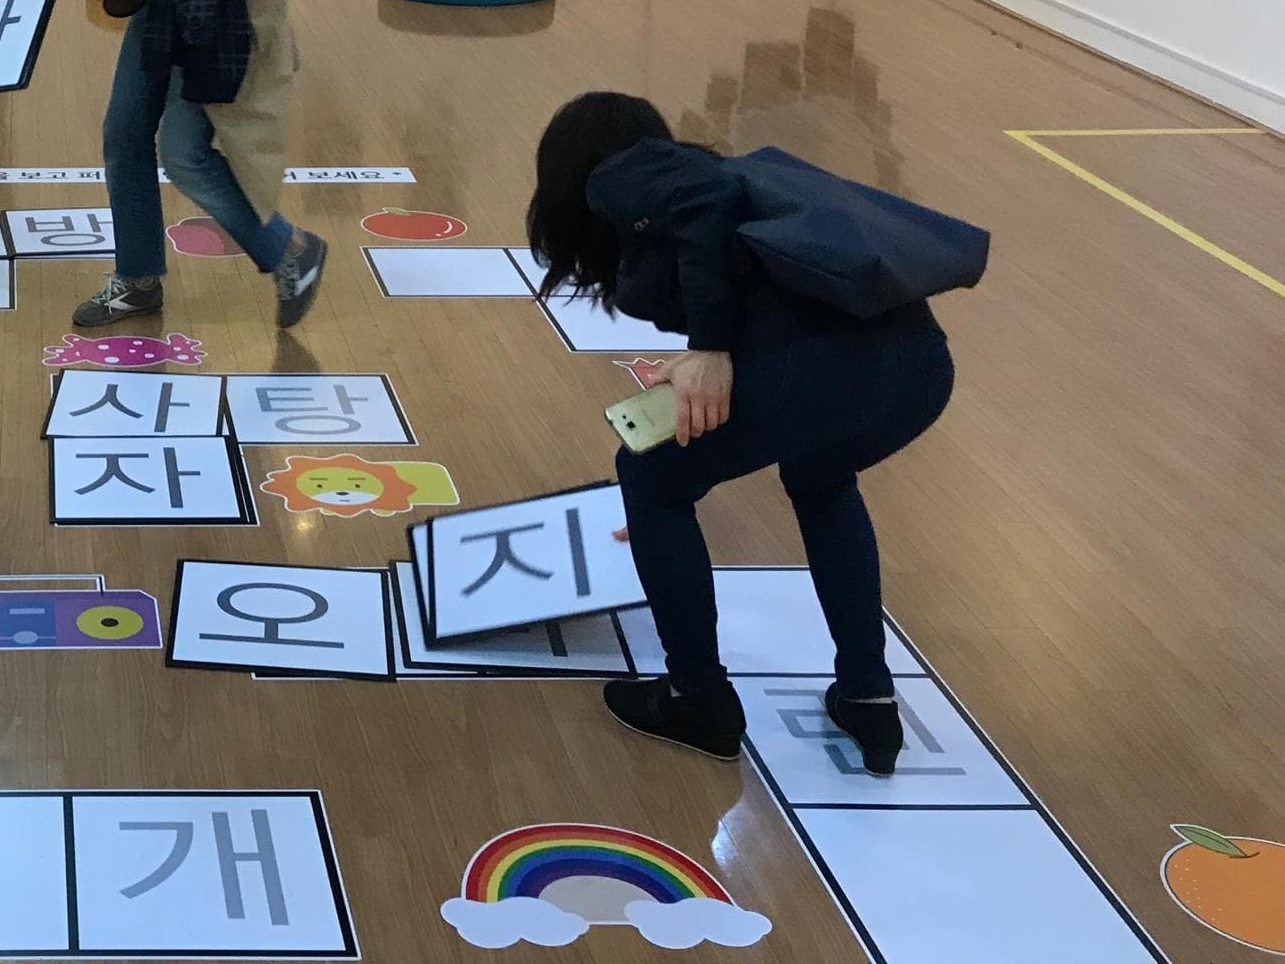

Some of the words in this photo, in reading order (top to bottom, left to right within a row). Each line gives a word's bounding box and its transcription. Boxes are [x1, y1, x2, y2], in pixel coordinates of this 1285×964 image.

[307, 171, 384, 179] 보세요
[25, 213, 113, 246] 방
[69, 381, 191, 433] 사
[255, 384, 369, 436] 탕
[74, 446, 201, 509] 자
[458, 508, 592, 598] 지
[198, 581, 345, 649] 오
[119, 807, 289, 927] 개
